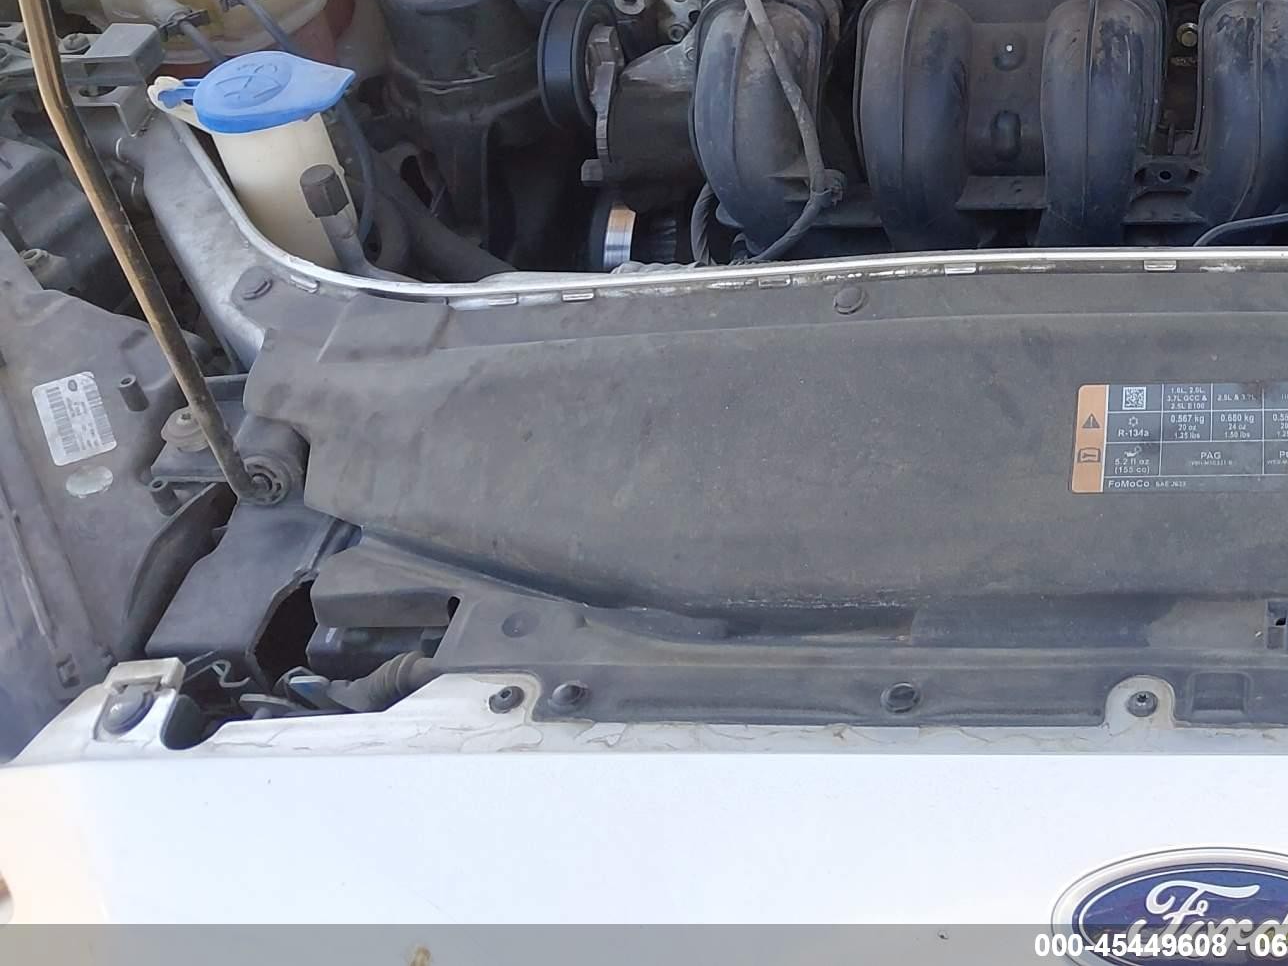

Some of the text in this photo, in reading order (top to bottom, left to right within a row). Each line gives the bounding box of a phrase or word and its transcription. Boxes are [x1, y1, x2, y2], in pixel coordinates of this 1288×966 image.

[1194, 415, 1205, 424] kg
[1244, 414, 1254, 423] kg
[1118, 429, 1150, 437] R-134a
[1200, 451, 1222, 460] PAG
[1114, 466, 1134, 474] (155
[1108, 479, 1150, 488] FoMoCo
